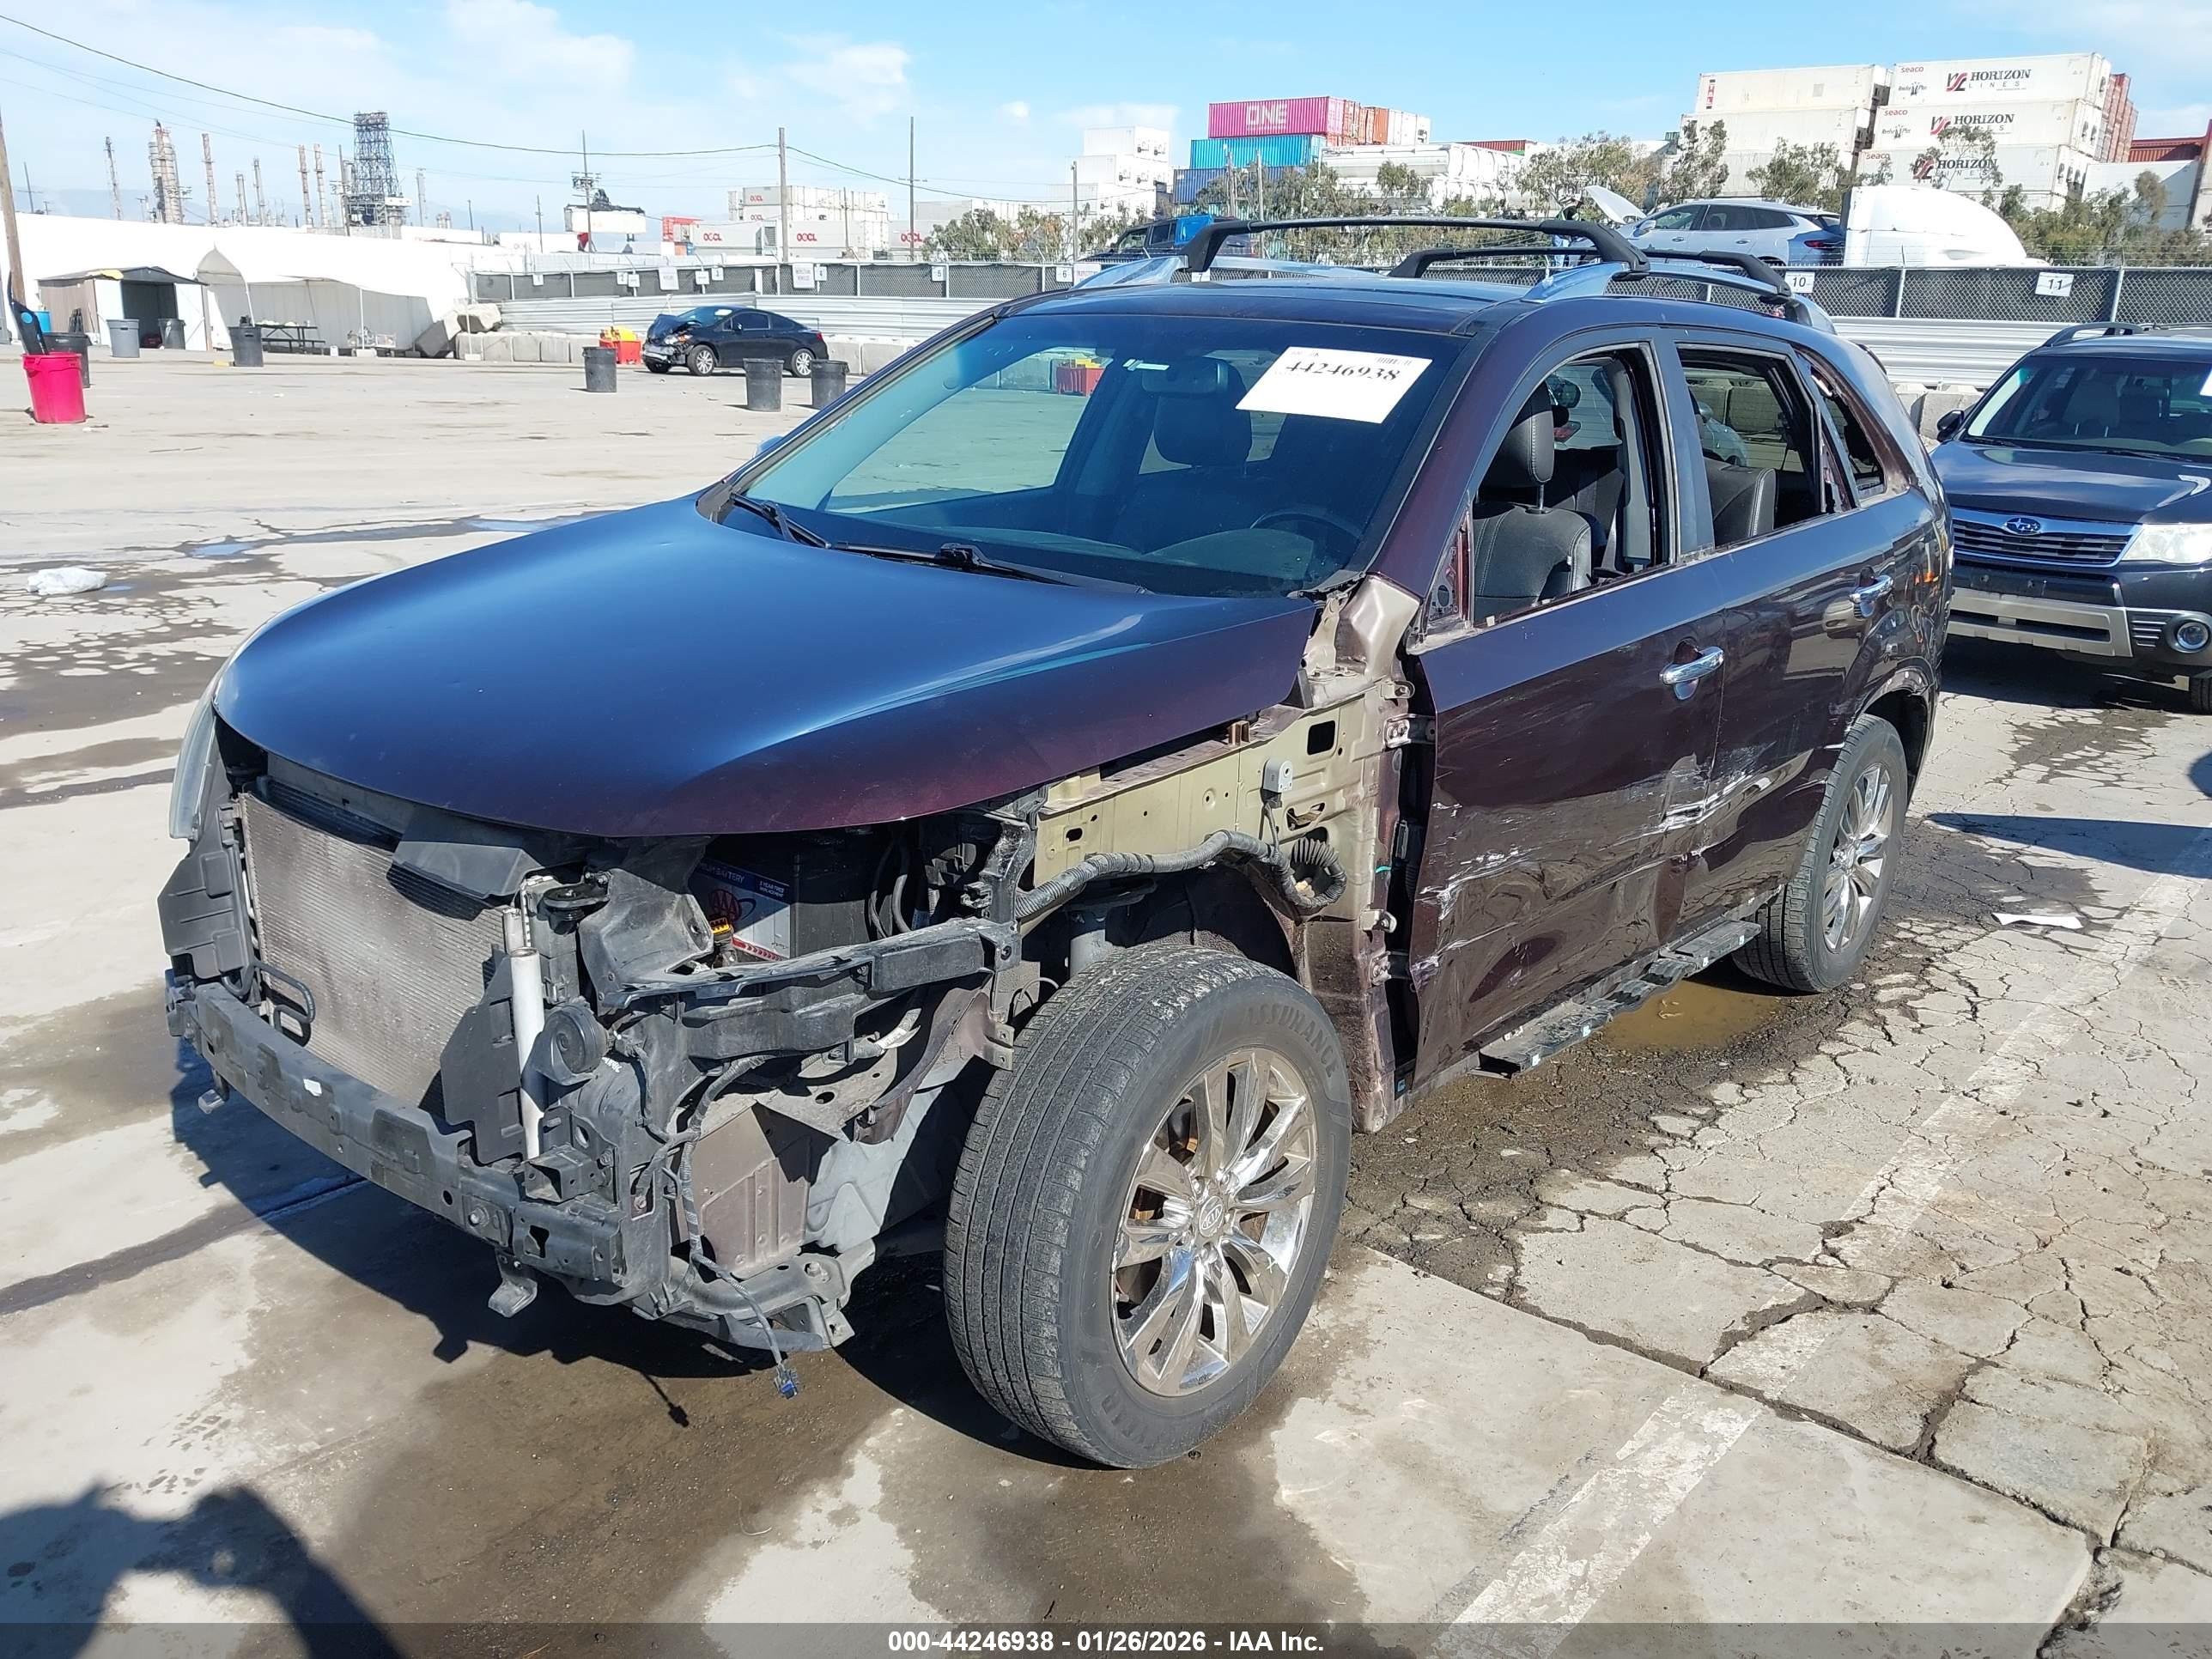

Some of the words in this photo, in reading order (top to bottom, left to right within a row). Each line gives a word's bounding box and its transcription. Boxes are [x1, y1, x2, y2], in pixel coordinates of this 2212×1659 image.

[1970, 69, 2032, 82] HORIZON
[1245, 104, 1287, 126] ONE
[1954, 113, 2014, 125] HORIZON
[1937, 158, 1998, 169] HORIZON
[797, 233, 817, 241] OOCL
[1792, 276, 1807, 288] 10
[2048, 278, 2063, 289] 11
[1286, 361, 1401, 380] 44246938
